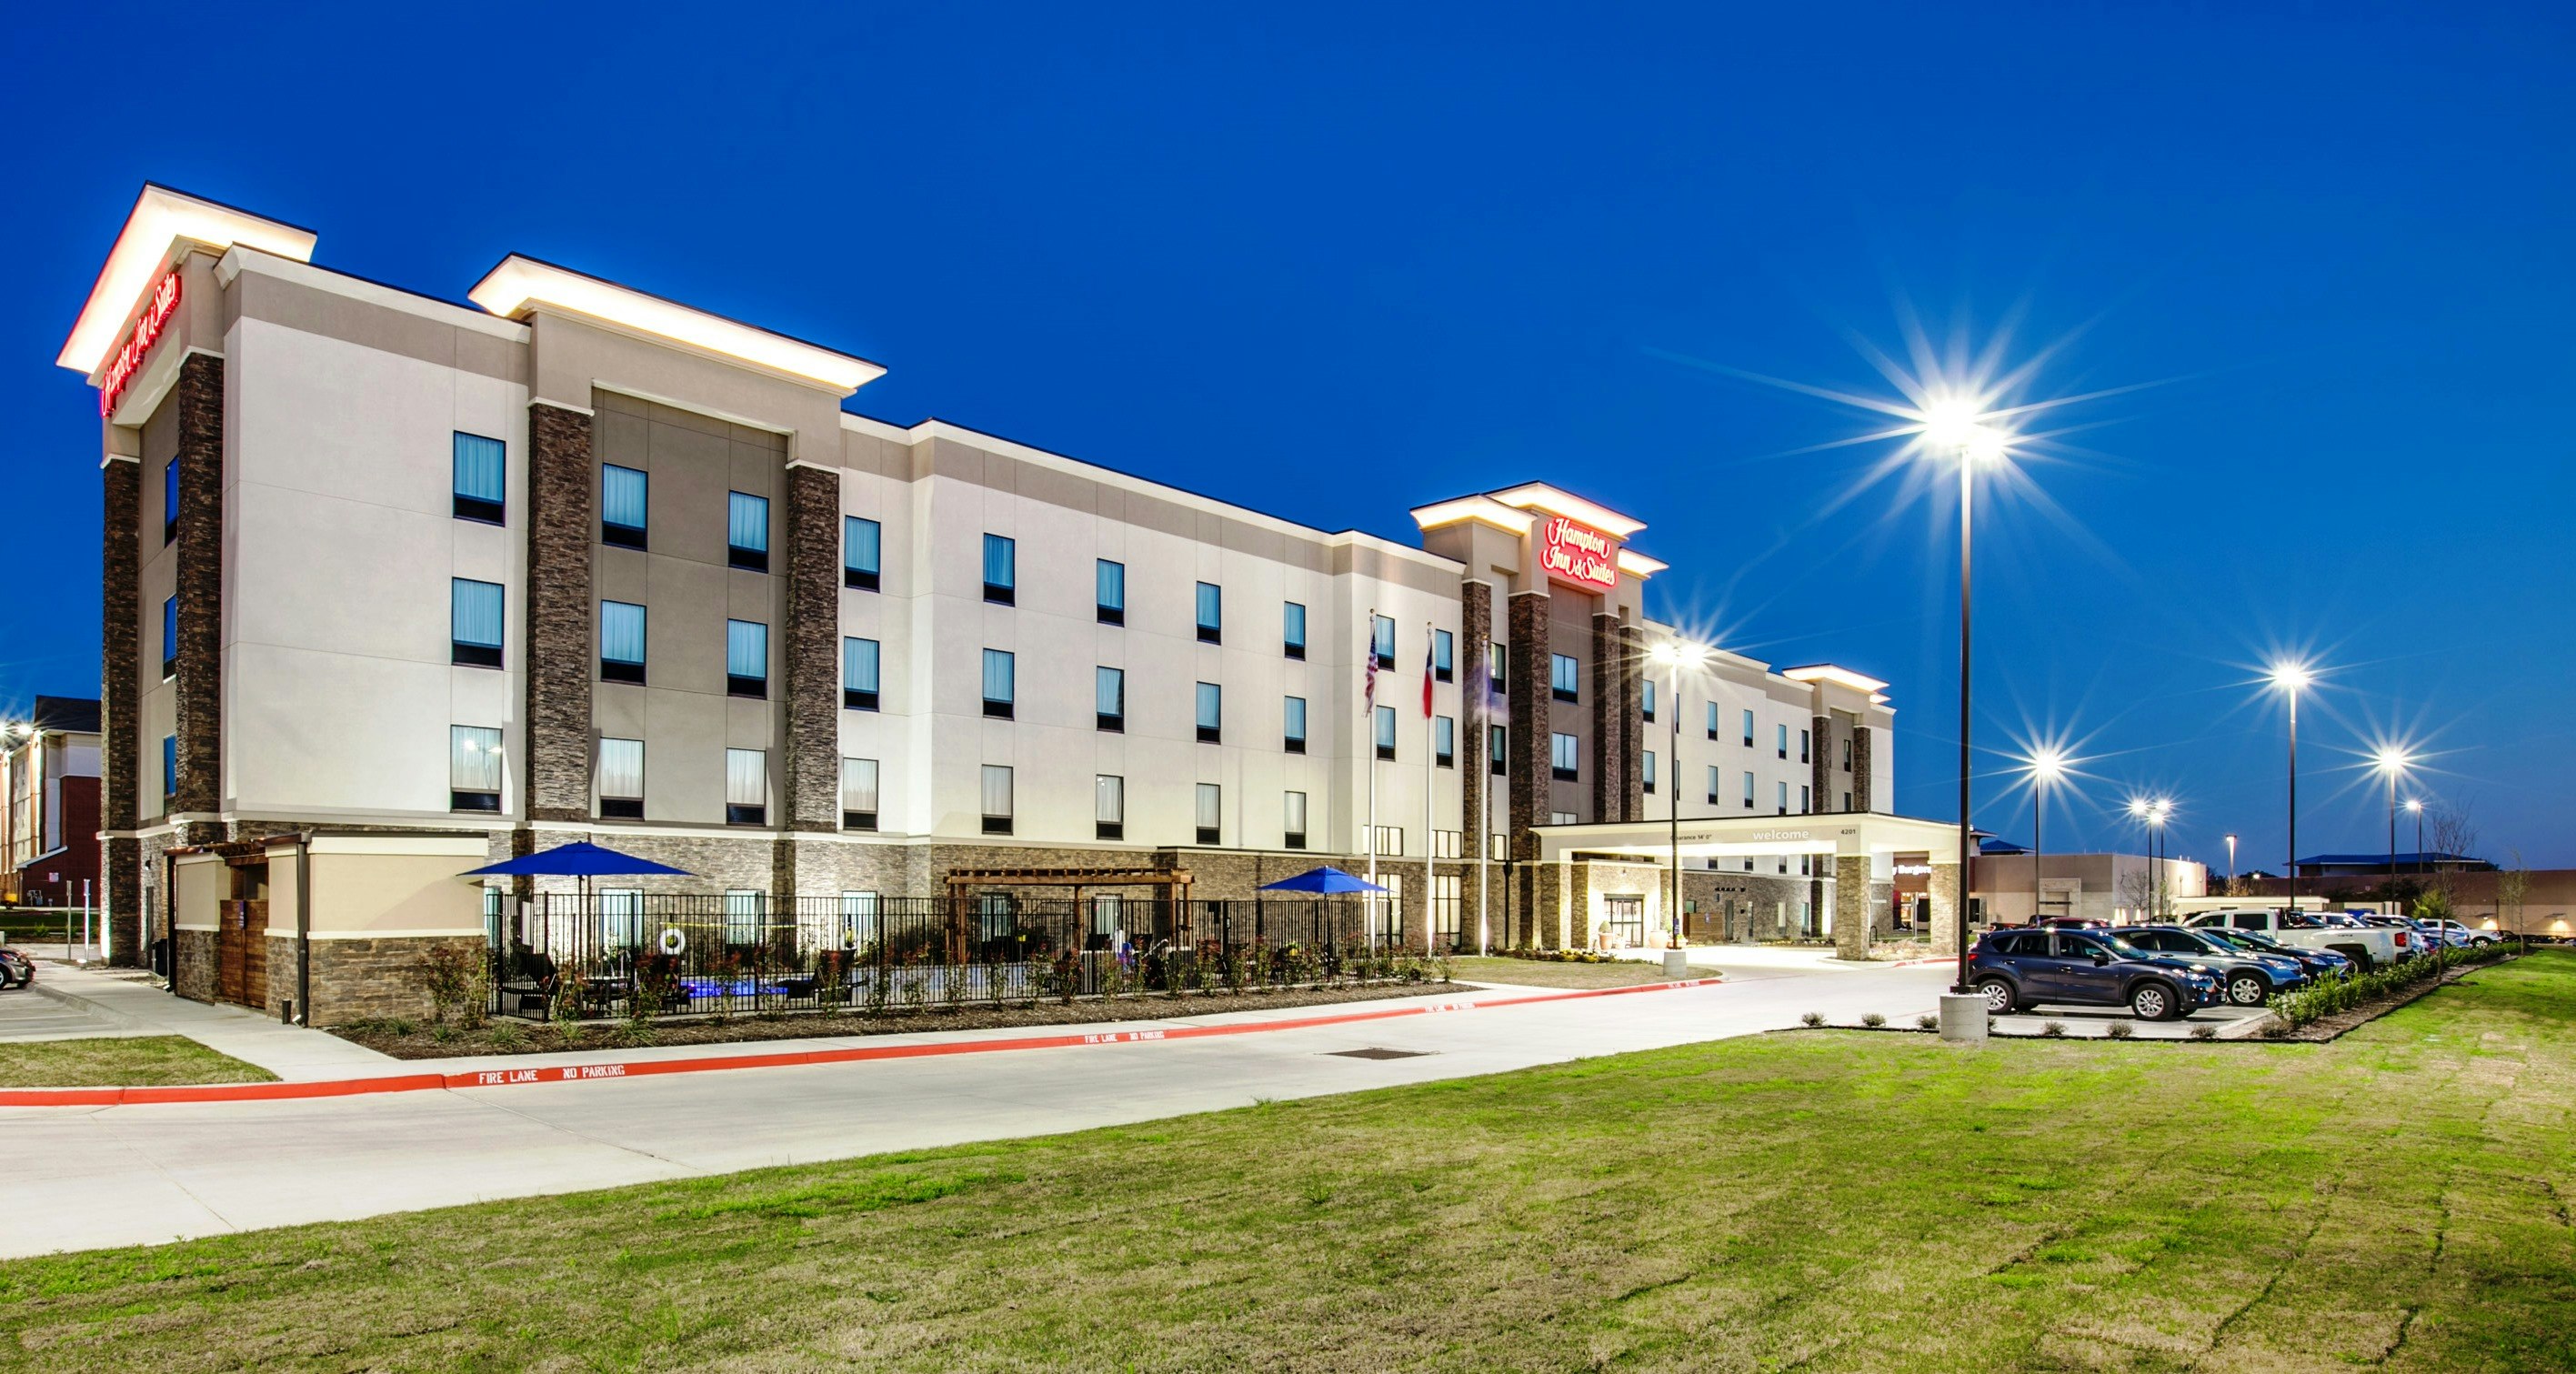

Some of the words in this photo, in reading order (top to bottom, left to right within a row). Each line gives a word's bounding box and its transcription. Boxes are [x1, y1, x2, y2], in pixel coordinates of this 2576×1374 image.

[1547, 517, 1610, 559] Hampton
[1542, 546, 1576, 576] Inn
[1574, 558, 1585, 580] &
[1582, 556, 1616, 586] Suites
[1752, 828, 1810, 840] welcome
[1085, 1035, 1099, 1044] FIRE
[1101, 1033, 1118, 1043] LANE
[1129, 1031, 1139, 1041] NO
[1140, 1030, 1164, 1040] PARKING
[478, 1072, 505, 1085] FIRE
[509, 1069, 539, 1082] LANE
[562, 1068, 577, 1079] NO
[582, 1064, 626, 1078] PARKING
